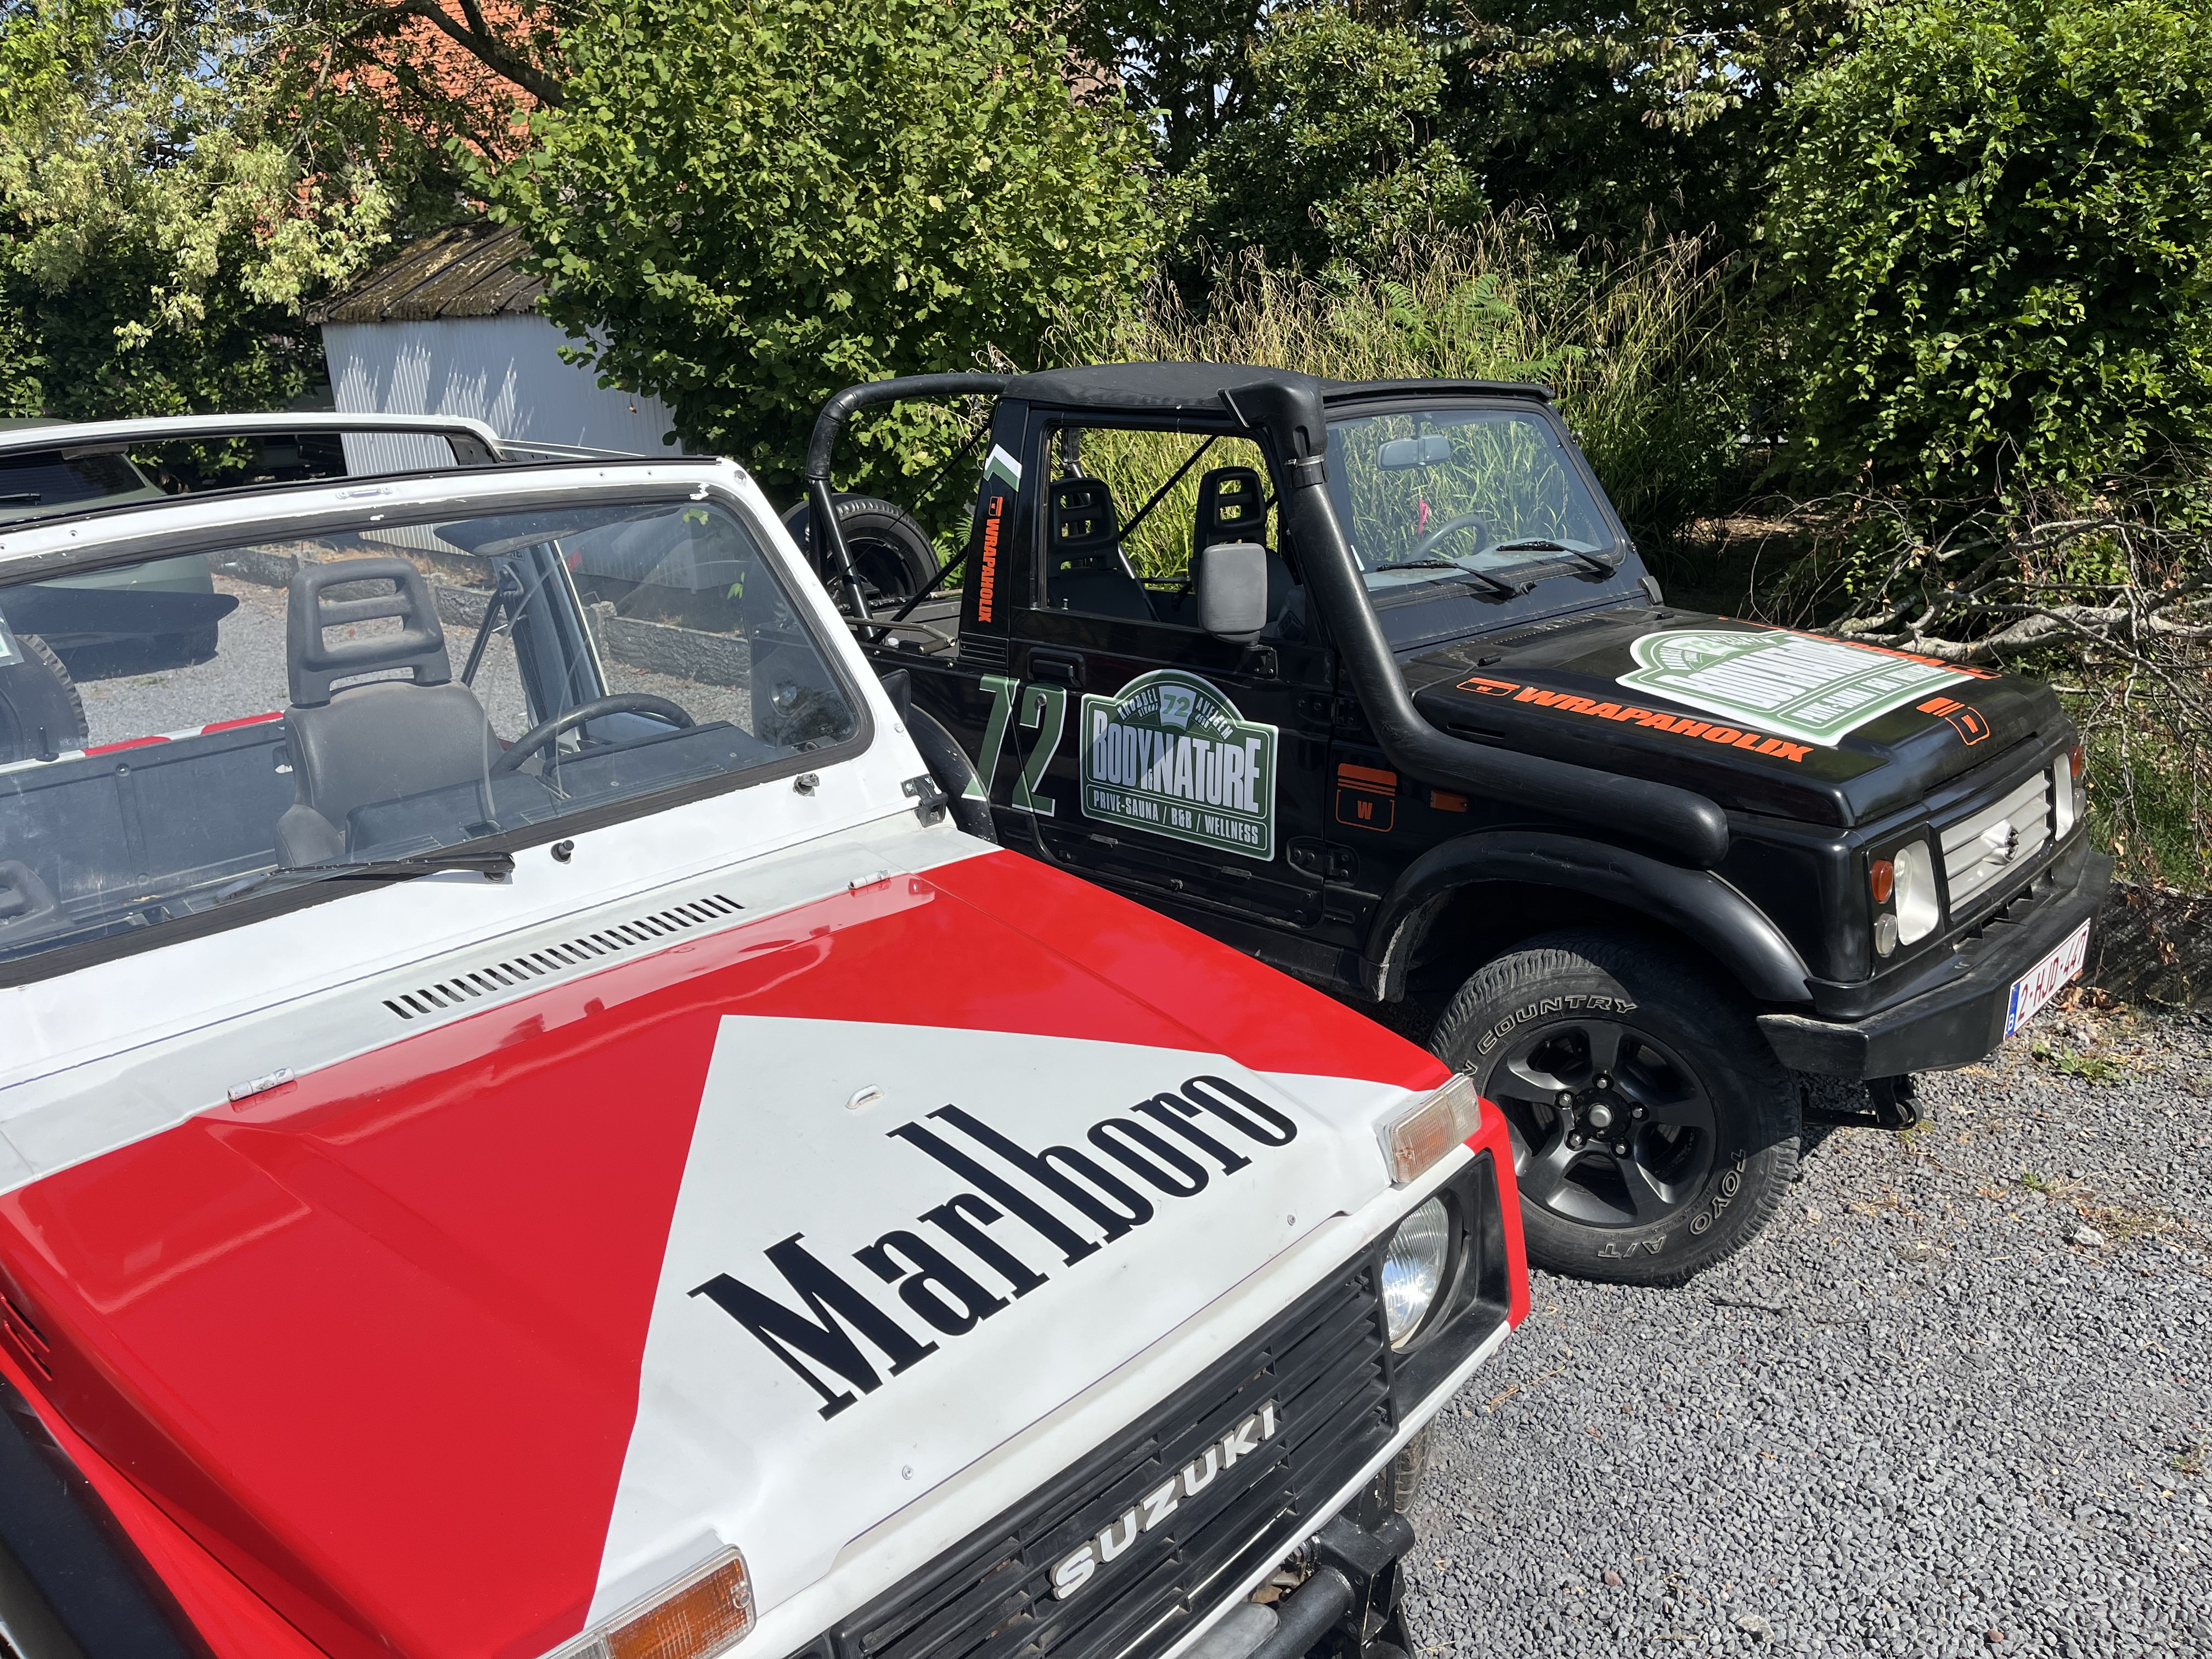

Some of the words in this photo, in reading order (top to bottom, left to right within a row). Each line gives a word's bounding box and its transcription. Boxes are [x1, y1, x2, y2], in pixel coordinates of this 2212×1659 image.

[979, 518, 1000, 623] WRAPAHOLIX
[1117, 688, 1158, 720] KNOBBEL
[1163, 694, 1190, 718] 72
[1195, 697, 1233, 740] AVELGEM
[1512, 686, 1814, 763] WRAPAHOLIX
[961, 674, 1066, 817] 72
[1093, 789, 1159, 821] PRIVE-SAUNA
[1171, 807, 1192, 829] B&B
[1204, 815, 1259, 844] WELLNESS
[1357, 800, 1373, 820] W
[1477, 995, 1638, 1055] COUNTRY
[2007, 1013, 2015, 1032] B
[1689, 1149, 1746, 1235] TOYO
[686, 1075, 1297, 1422] Marlboro
[1597, 1235, 1666, 1260] A/T
[1051, 1402, 1276, 1600] SUZUKI
